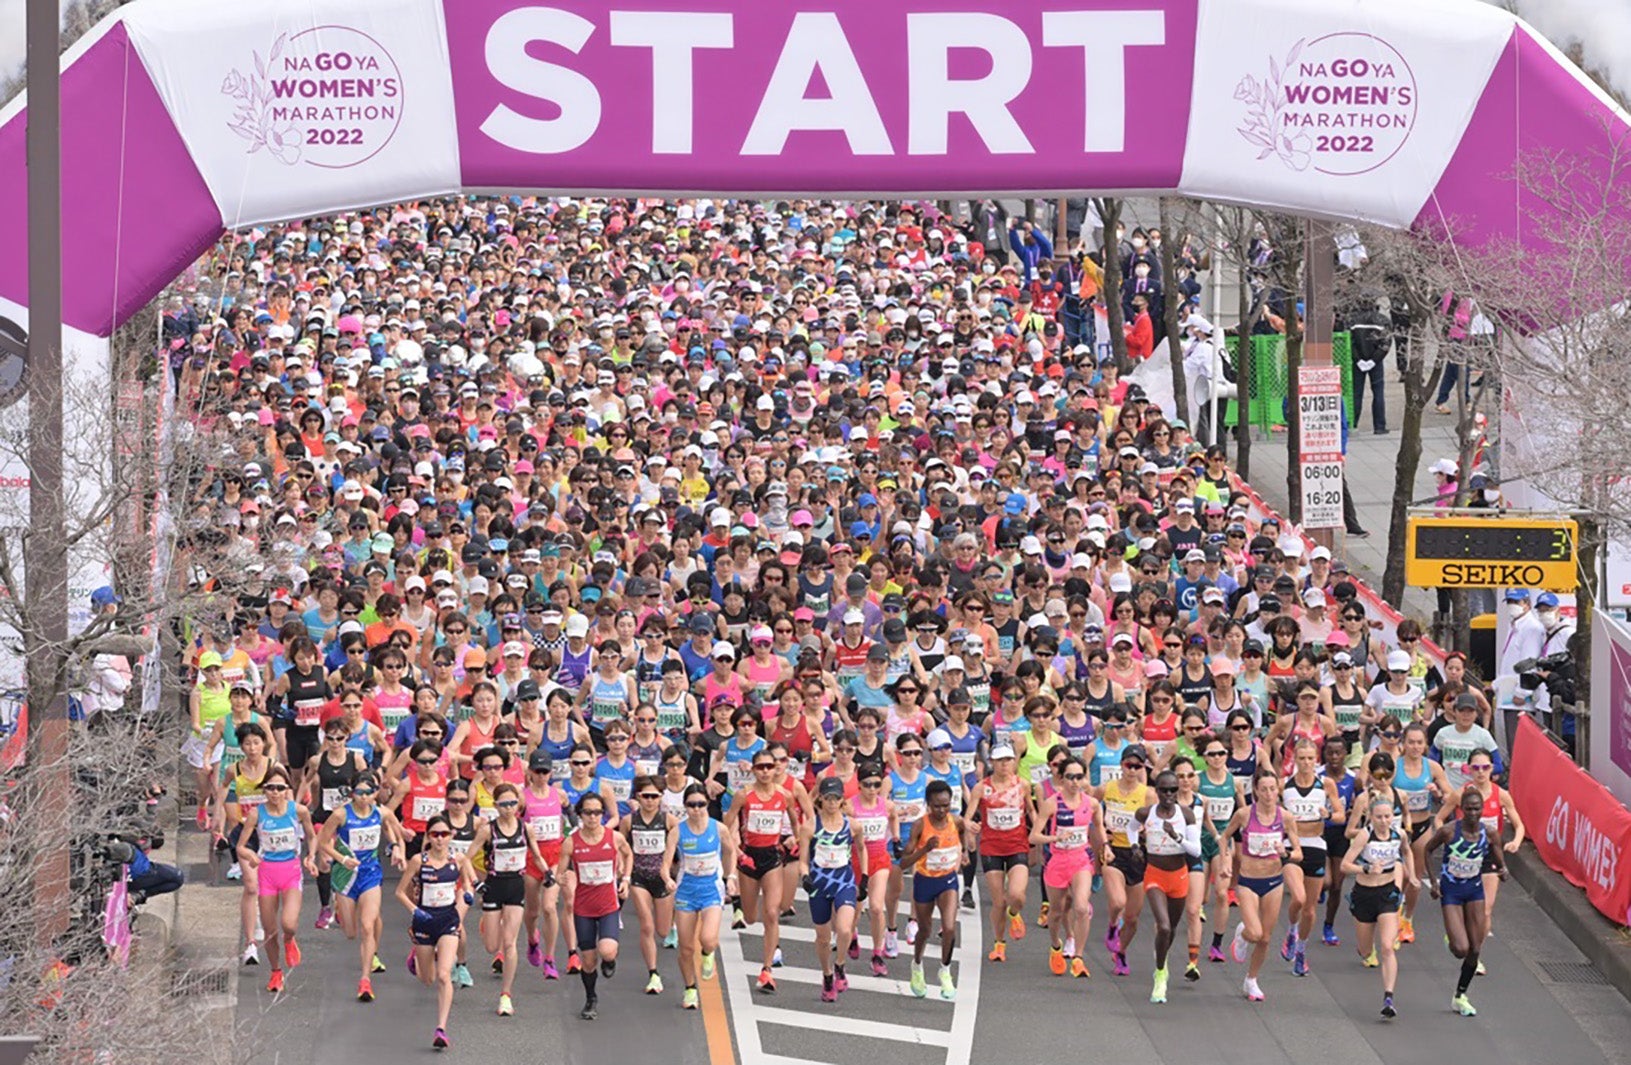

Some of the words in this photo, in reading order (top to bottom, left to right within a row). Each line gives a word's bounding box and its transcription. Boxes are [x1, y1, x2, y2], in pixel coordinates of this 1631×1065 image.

[284, 52, 379, 71] NAGOYA
[1299, 59, 1395, 78] NAGOYA
[271, 78, 398, 98] WOMEN'S
[478, 6, 1166, 156] START
[1284, 85, 1412, 105] WOMEN'S
[272, 106, 395, 121] MARATHON
[1283, 112, 1407, 128] MARATHON
[306, 129, 364, 145] 2022
[1316, 135, 1374, 152] 2022
[1304, 465, 1340, 479] 06:00
[1306, 491, 1341, 505] 16:20
[1442, 564, 1544, 585] SEIKO
[422, 805, 439, 813] 125
[1210, 804, 1228, 813] 114
[1295, 804, 1314, 812] 112
[1546, 795, 1569, 850] GO
[639, 838, 658, 846] 110
